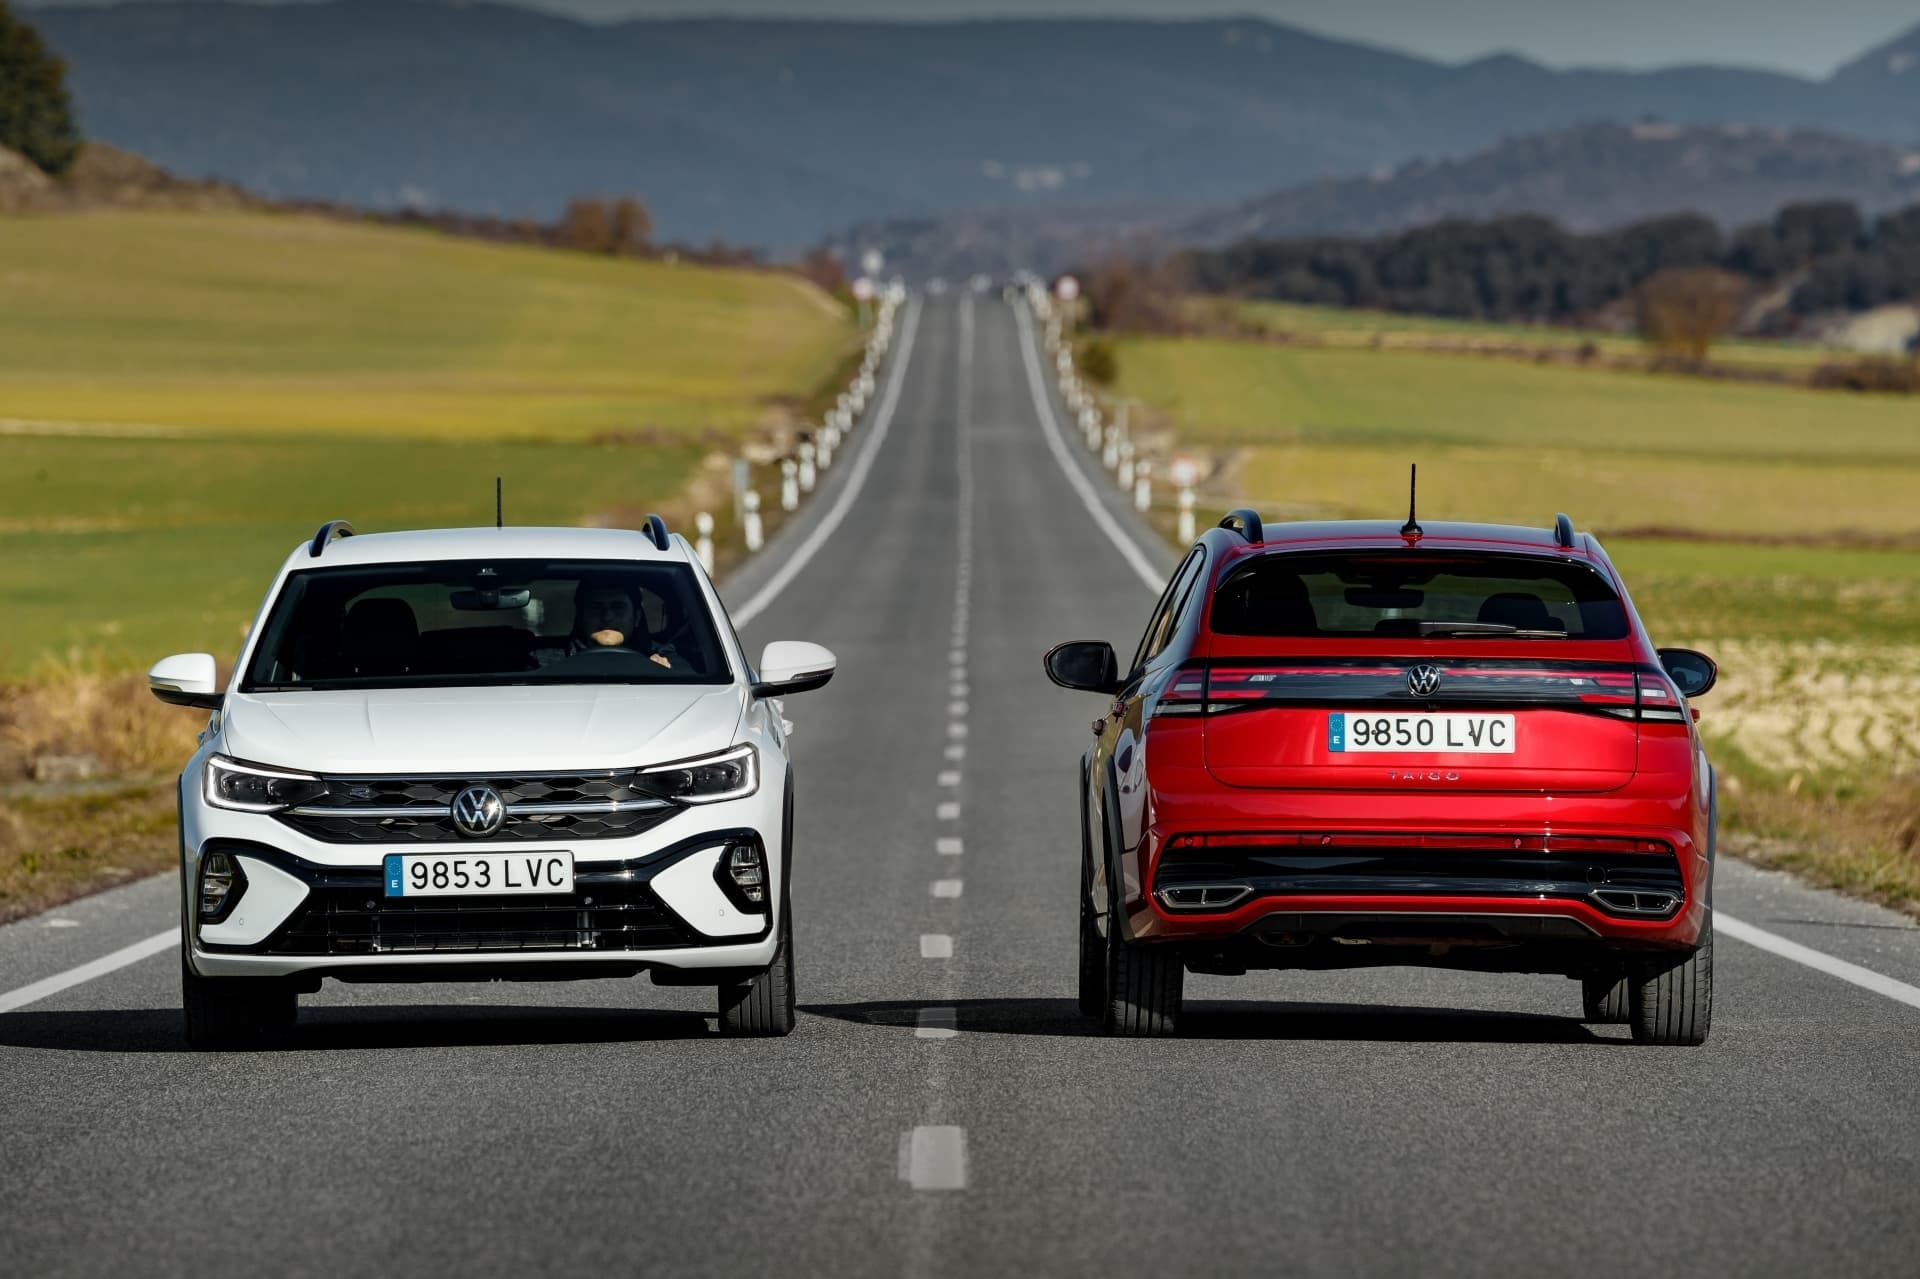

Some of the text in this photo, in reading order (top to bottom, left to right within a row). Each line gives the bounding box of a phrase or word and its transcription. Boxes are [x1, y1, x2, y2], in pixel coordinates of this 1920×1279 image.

[1333, 718, 1506, 747] E 9850 LVC
[1387, 770, 1460, 781] TAIGO
[391, 858, 564, 889] E 9853 LVC
